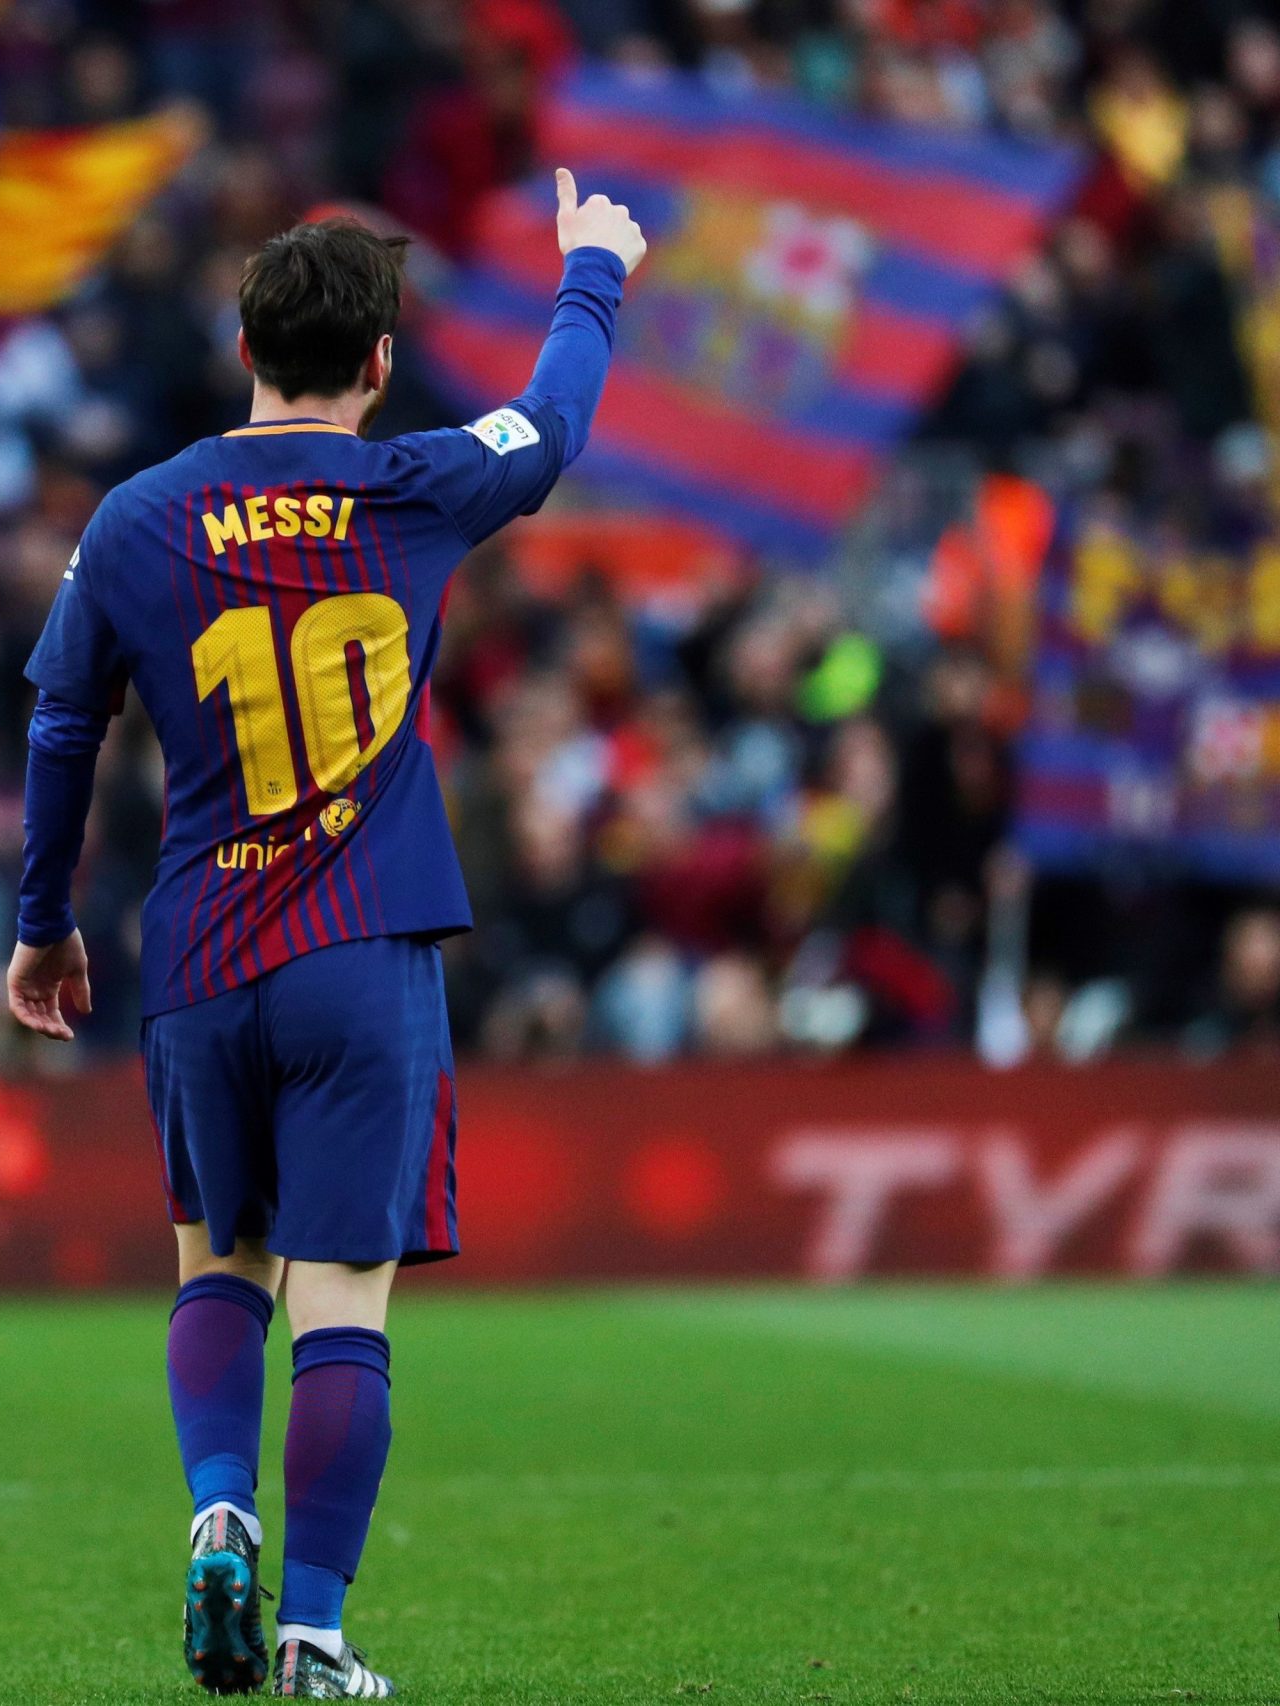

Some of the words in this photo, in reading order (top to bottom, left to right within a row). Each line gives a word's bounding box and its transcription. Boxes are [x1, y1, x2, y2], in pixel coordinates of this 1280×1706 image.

[201, 495, 355, 556] MESSI
[191, 592, 412, 817] 10
[772, 1128, 1280, 1283] TYR
